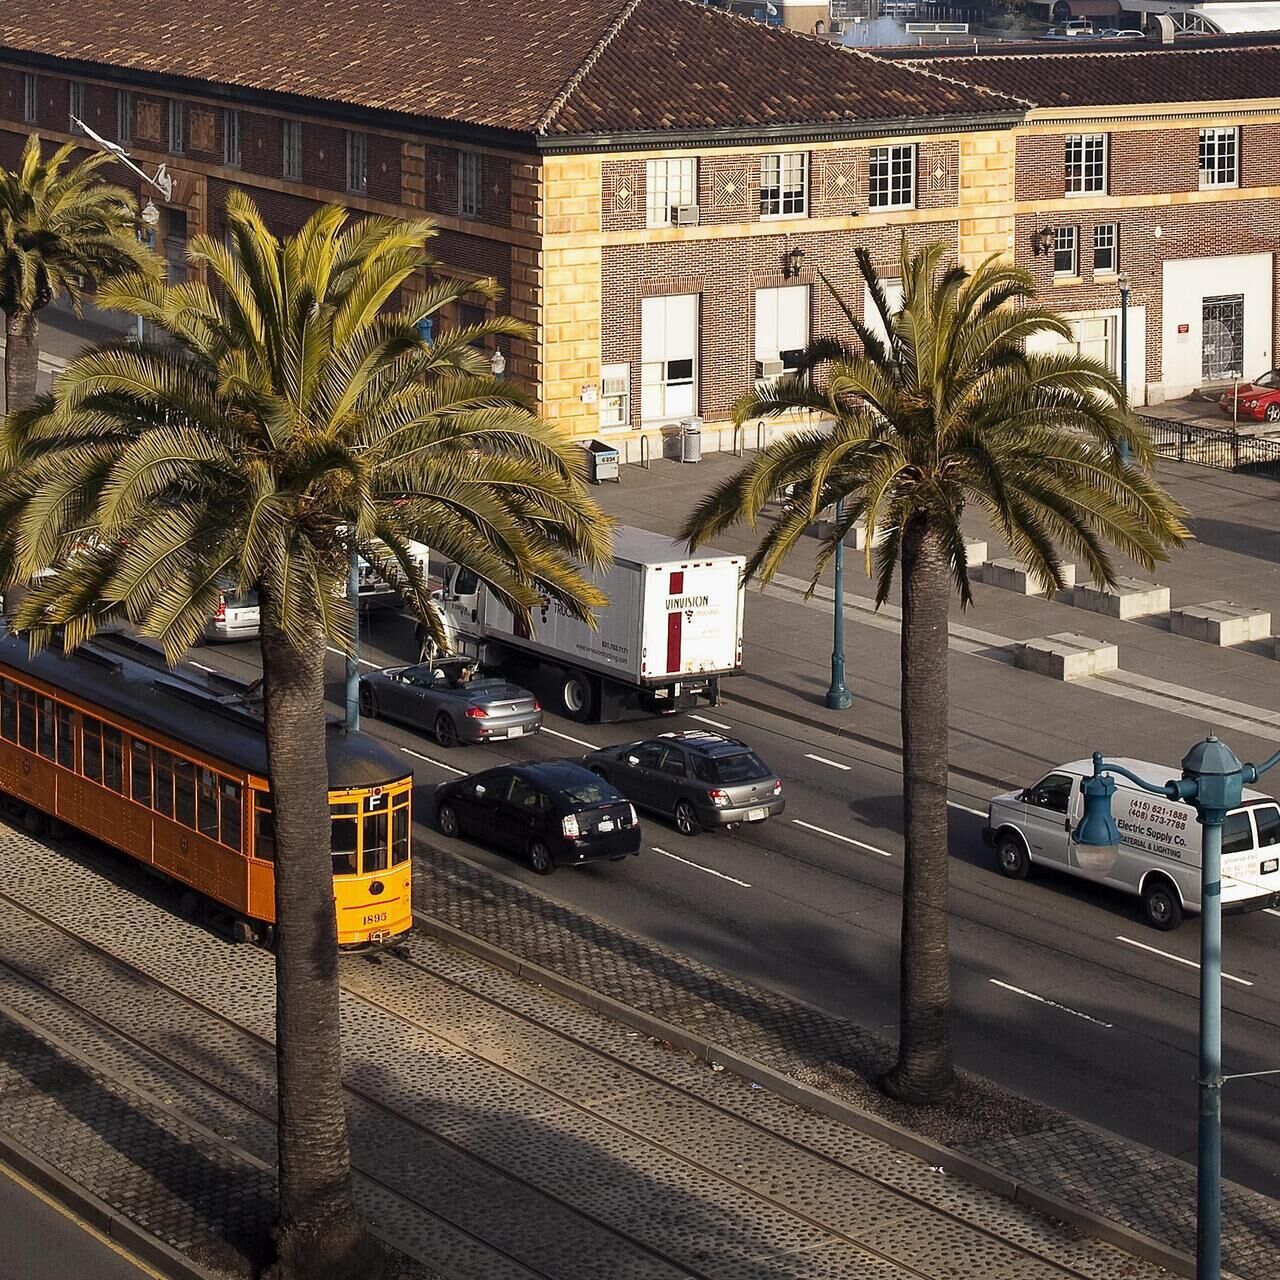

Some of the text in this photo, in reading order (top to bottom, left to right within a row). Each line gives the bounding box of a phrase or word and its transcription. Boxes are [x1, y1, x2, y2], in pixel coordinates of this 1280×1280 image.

[665, 595, 709, 610] VINVISION
[369, 795, 381, 811] F
[1130, 799, 1188, 822] (415) 621-1888
[1128, 808, 1186, 831] (408) 573-7788
[1117, 818, 1187, 847] Electric Supply Co.
[1153, 842, 1181, 859] LIGHTING
[363, 912, 387, 926] 1895
